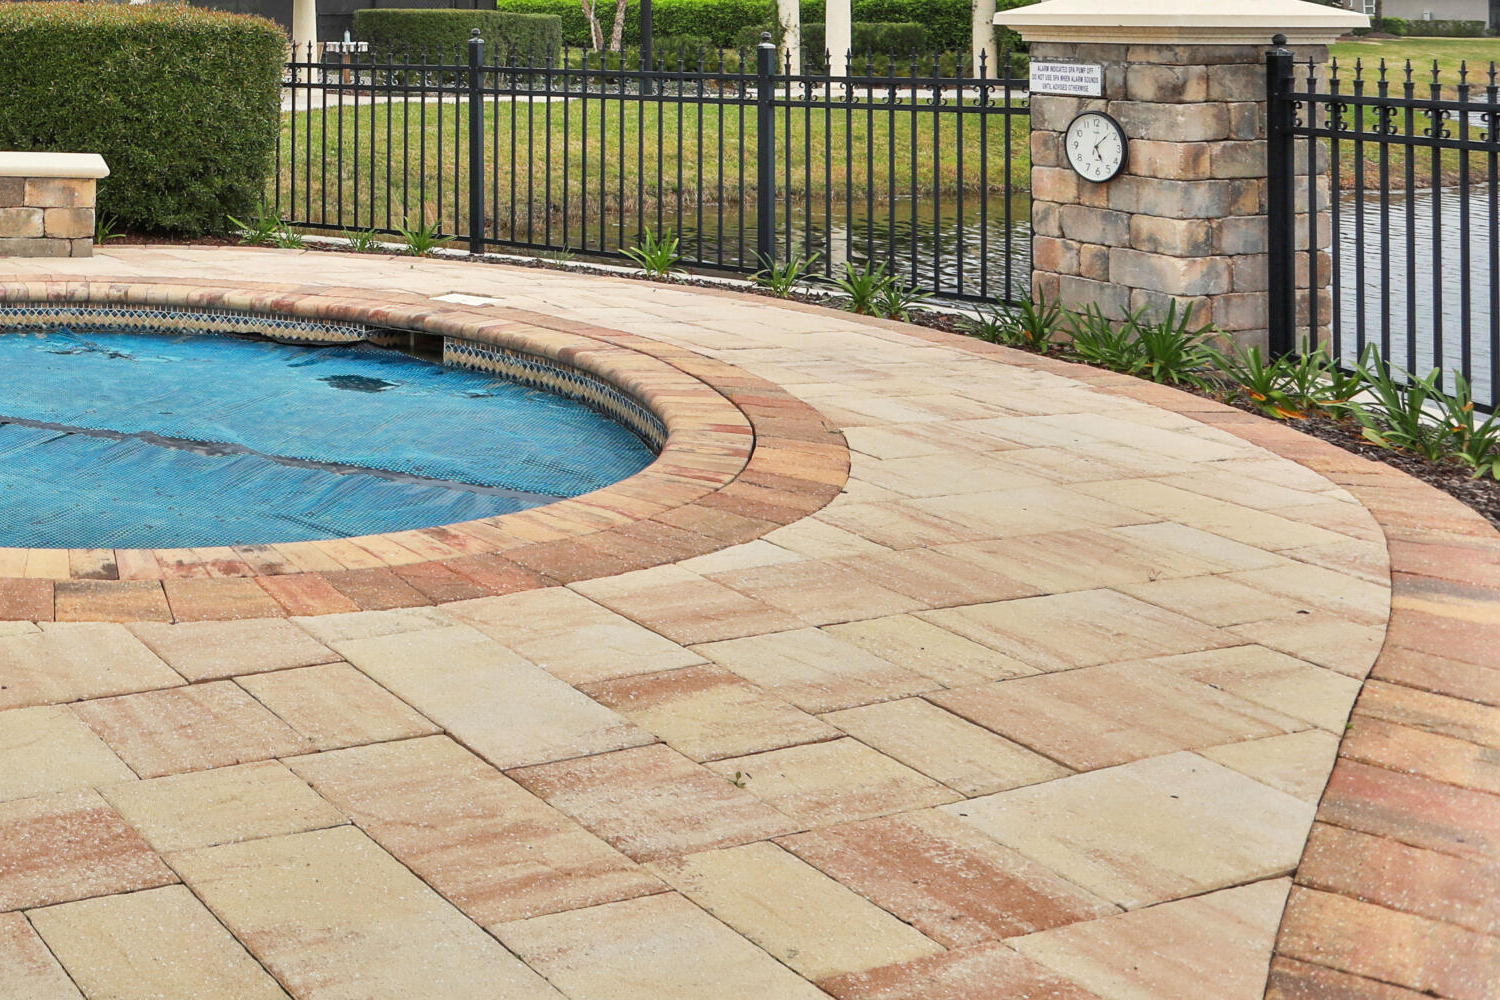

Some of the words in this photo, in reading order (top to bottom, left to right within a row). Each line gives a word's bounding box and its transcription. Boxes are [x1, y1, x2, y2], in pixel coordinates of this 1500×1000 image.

[1093, 118, 1100, 127] 12
[1112, 132, 1118, 140] 2
[1074, 140, 1078, 150] 9
[1116, 144, 1120, 154] 3
[1113, 157, 1118, 165] 4
[1086, 162, 1090, 171] 7
[1106, 164, 1110, 174] 5
[1095, 167, 1100, 176] 6
